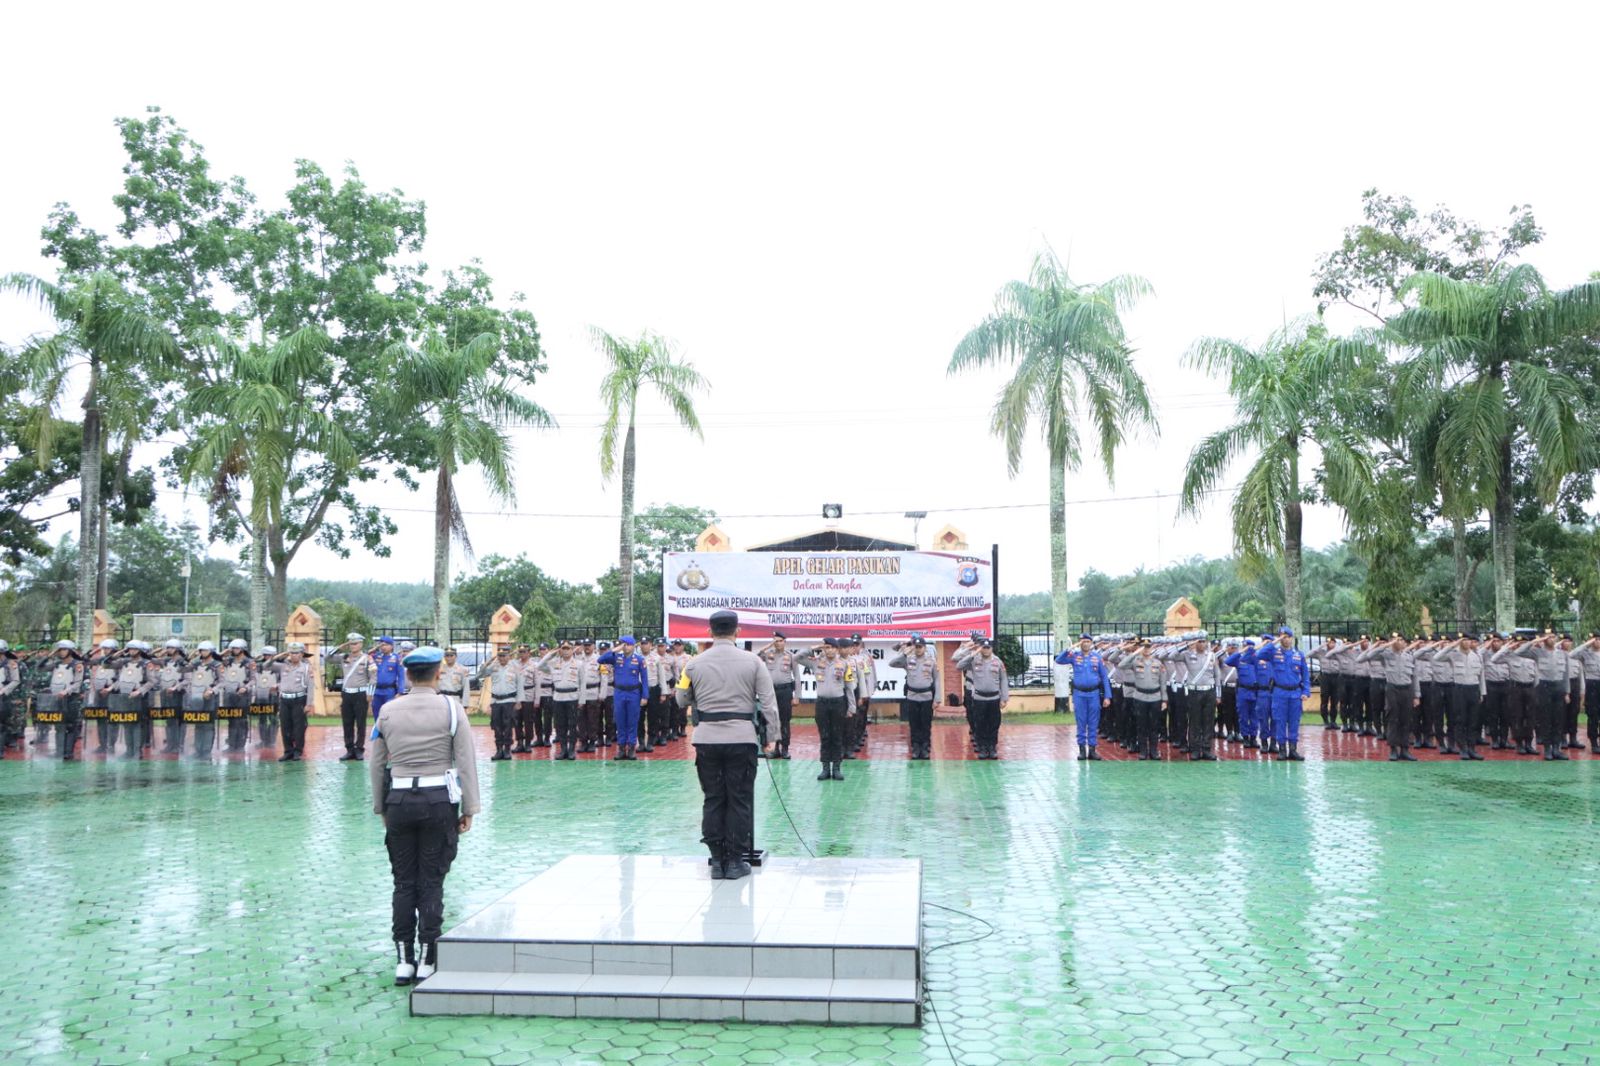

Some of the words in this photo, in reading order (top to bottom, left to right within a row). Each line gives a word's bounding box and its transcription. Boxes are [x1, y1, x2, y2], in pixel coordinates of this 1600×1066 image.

[773, 557, 804, 575] APEL
[806, 557, 847, 575] GELAR
[847, 556, 901, 575] PASUKAN
[793, 579, 823, 591] Dalam
[826, 578, 862, 593] Rangka
[677, 597, 730, 608] KESIAPSIAGAAN
[730, 597, 777, 608] PENGAMANAN
[779, 597, 801, 608] TAHAP
[802, 597, 839, 608] KAMPANYE
[840, 596, 869, 608] OPERASI
[870, 596, 898, 608] MANTAP
[900, 596, 922, 608] BRATA
[923, 596, 956, 608] LANCANG
[957, 596, 985, 608] KUNING
[768, 614, 791, 624] TAHUN
[792, 614, 825, 624] 2023-2024
[826, 614, 834, 624] DI
[834, 614, 874, 624] KABUPATEN
[876, 614, 893, 624] SIAK
[84, 709, 108, 718] POLISI
[150, 709, 175, 718] POLISI
[217, 708, 243, 718] POLISI
[249, 705, 274, 714] POLISI
[36, 712, 63, 722] POLISI
[110, 712, 138, 722] POLISI
[184, 712, 210, 722] POLISI
